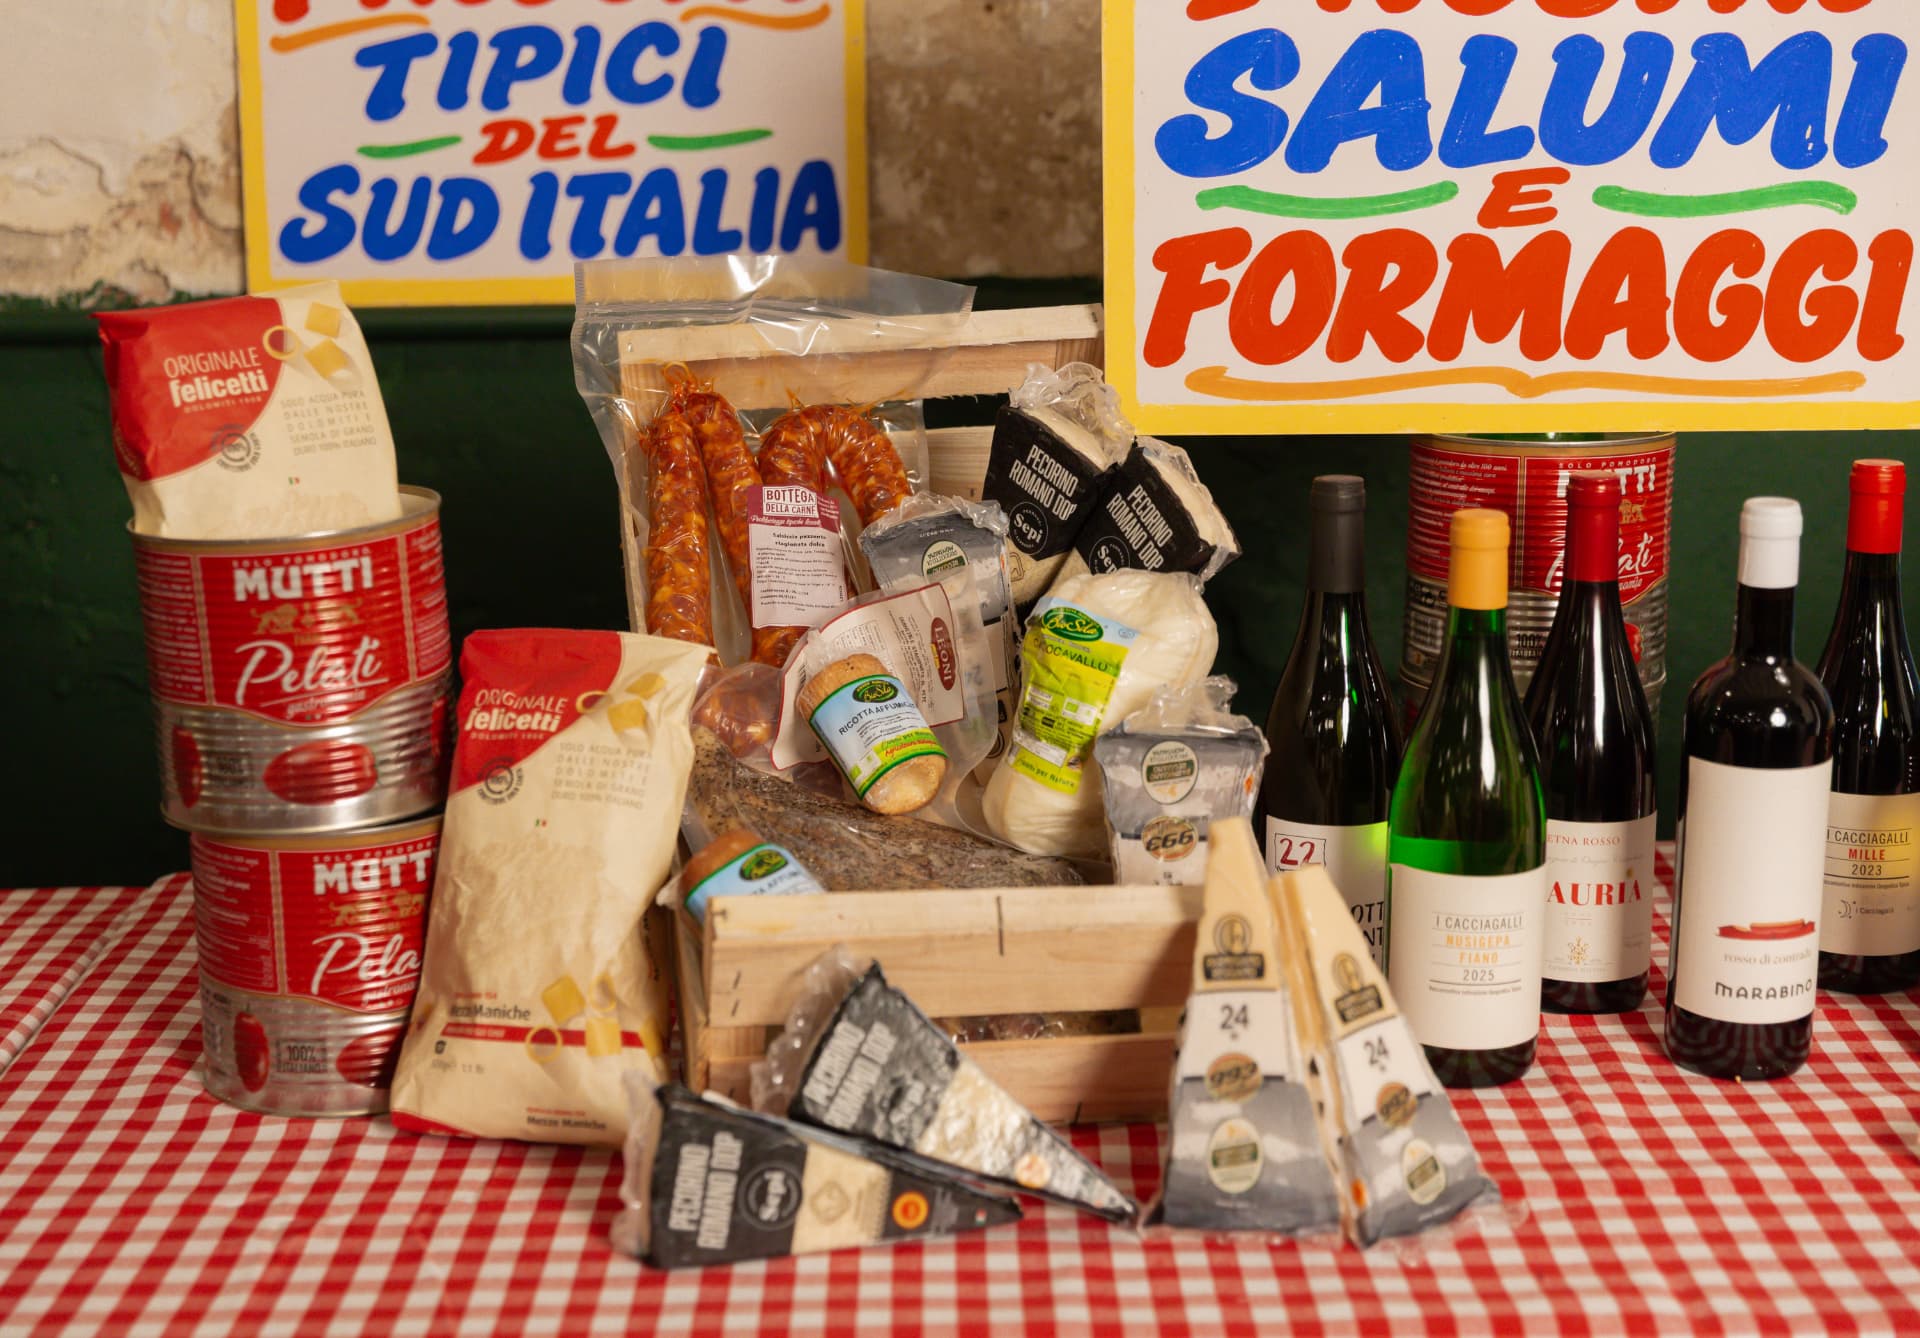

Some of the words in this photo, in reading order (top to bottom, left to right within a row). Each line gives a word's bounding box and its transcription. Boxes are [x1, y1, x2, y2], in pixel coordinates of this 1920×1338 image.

[354, 21, 728, 121] TIPICI
[1154, 28, 1908, 178] SALUMI
[471, 113, 636, 166] DEL
[279, 164, 500, 264] SUD
[518, 159, 842, 261] ITALIA
[1476, 166, 1571, 229] E
[1142, 226, 1914, 368] FORMAGGI
[163, 346, 261, 378] ORIGINALE
[169, 369, 269, 407] felicetti
[1026, 444, 1079, 497] PECORINO
[1558, 462, 1592, 470] SOLO
[1601, 456, 1657, 468] POMODORO
[766, 488, 815, 504] BOTTEGA
[1008, 459, 1055, 508] ROMANO
[1052, 493, 1078, 521] DOP
[765, 503, 789, 513] DELLA
[792, 506, 816, 515] CARNE
[1126, 484, 1173, 548] PECORINO
[1014, 513, 1043, 544] Sepi
[1106, 492, 1148, 550] ROMANO
[1138, 539, 1165, 570] DOP
[1097, 545, 1118, 575] Sep
[233, 556, 373, 602] MUTTI
[935, 626, 953, 681] LEONI
[234, 636, 381, 706] Pelati
[474, 689, 568, 714] ORIGINALE
[465, 708, 561, 732] felicetti
[838, 708, 874, 736] RICOTTA
[1279, 837, 1321, 866] 22
[1583, 836, 1621, 846] ROSSO
[1834, 830, 1908, 845] CACCIAGALLI
[1848, 848, 1886, 861] MILLE
[1851, 864, 1882, 876] 2023
[313, 850, 432, 896] MUTT
[1445, 915, 1523, 932] CACCIAGALLI
[311, 931, 421, 996] Pela
[1459, 951, 1499, 965] FIANO
[1463, 969, 1496, 983] 2025
[1714, 977, 1813, 1000] MARABINO
[1219, 1004, 1250, 1030] 24
[287, 1045, 318, 1062] 100%
[1363, 1034, 1390, 1066] 24
[710, 1131, 743, 1170] DOP
[668, 1143, 710, 1231] PECORINO
[759, 1171, 786, 1222] Sepi
[696, 1171, 738, 1250] ROMANO
